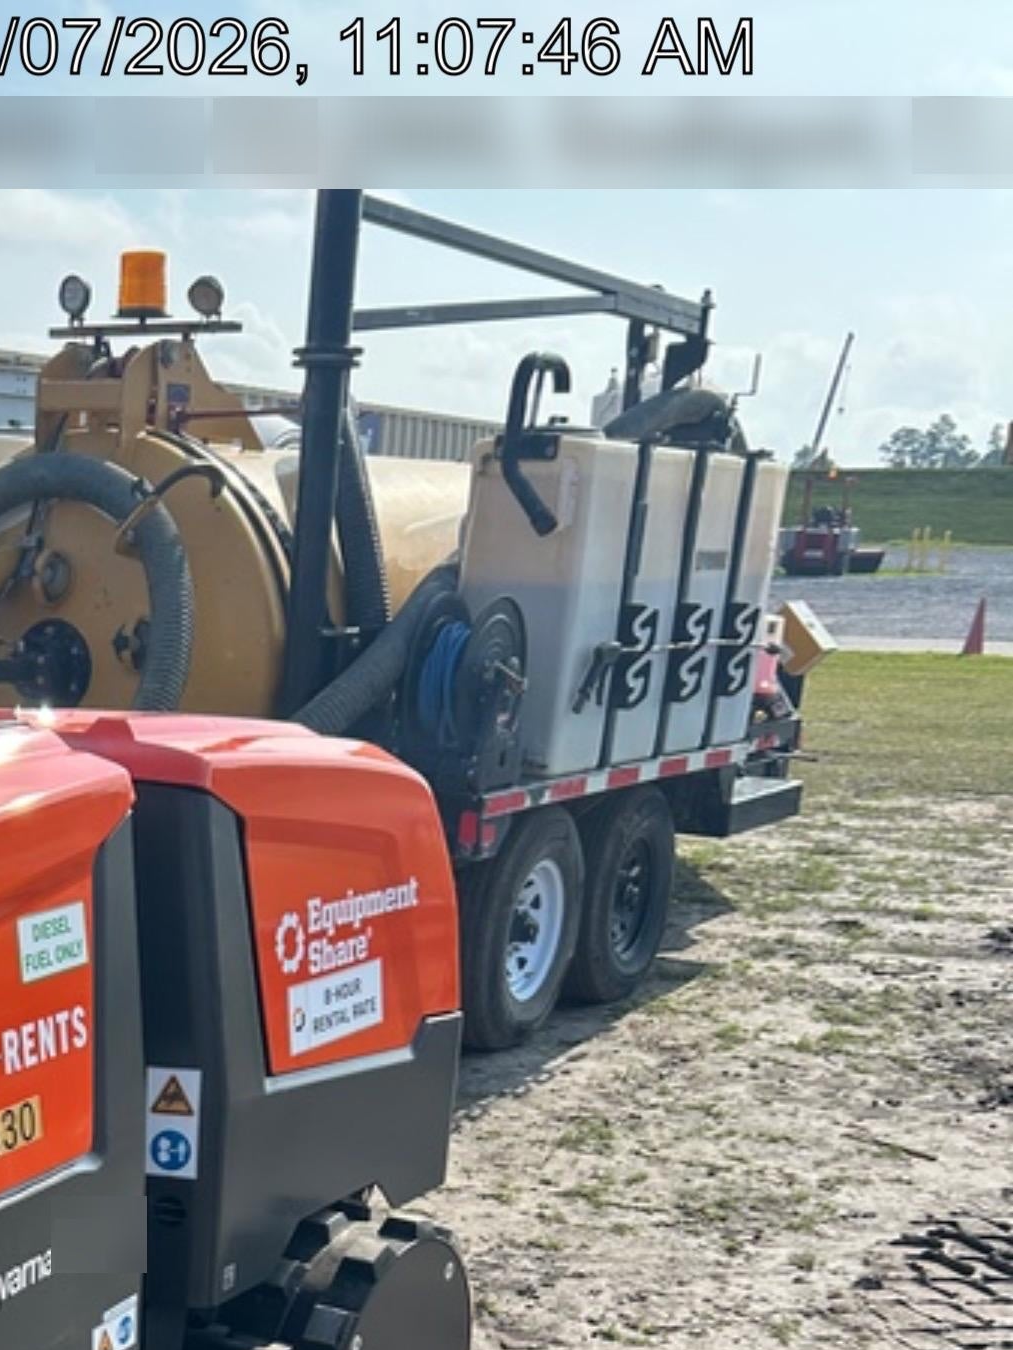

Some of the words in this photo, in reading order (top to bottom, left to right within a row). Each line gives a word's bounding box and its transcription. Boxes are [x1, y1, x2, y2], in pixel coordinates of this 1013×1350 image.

[307, 876, 419, 937] Equipment
[31, 915, 71, 943] DIESEL
[25, 950, 53, 973] FUEL
[54, 938, 84, 964] ONLY
[324, 977, 363, 1006] 8-HOUR
[313, 1008, 351, 1035] RENTAL
[352, 995, 377, 1019] RATE
